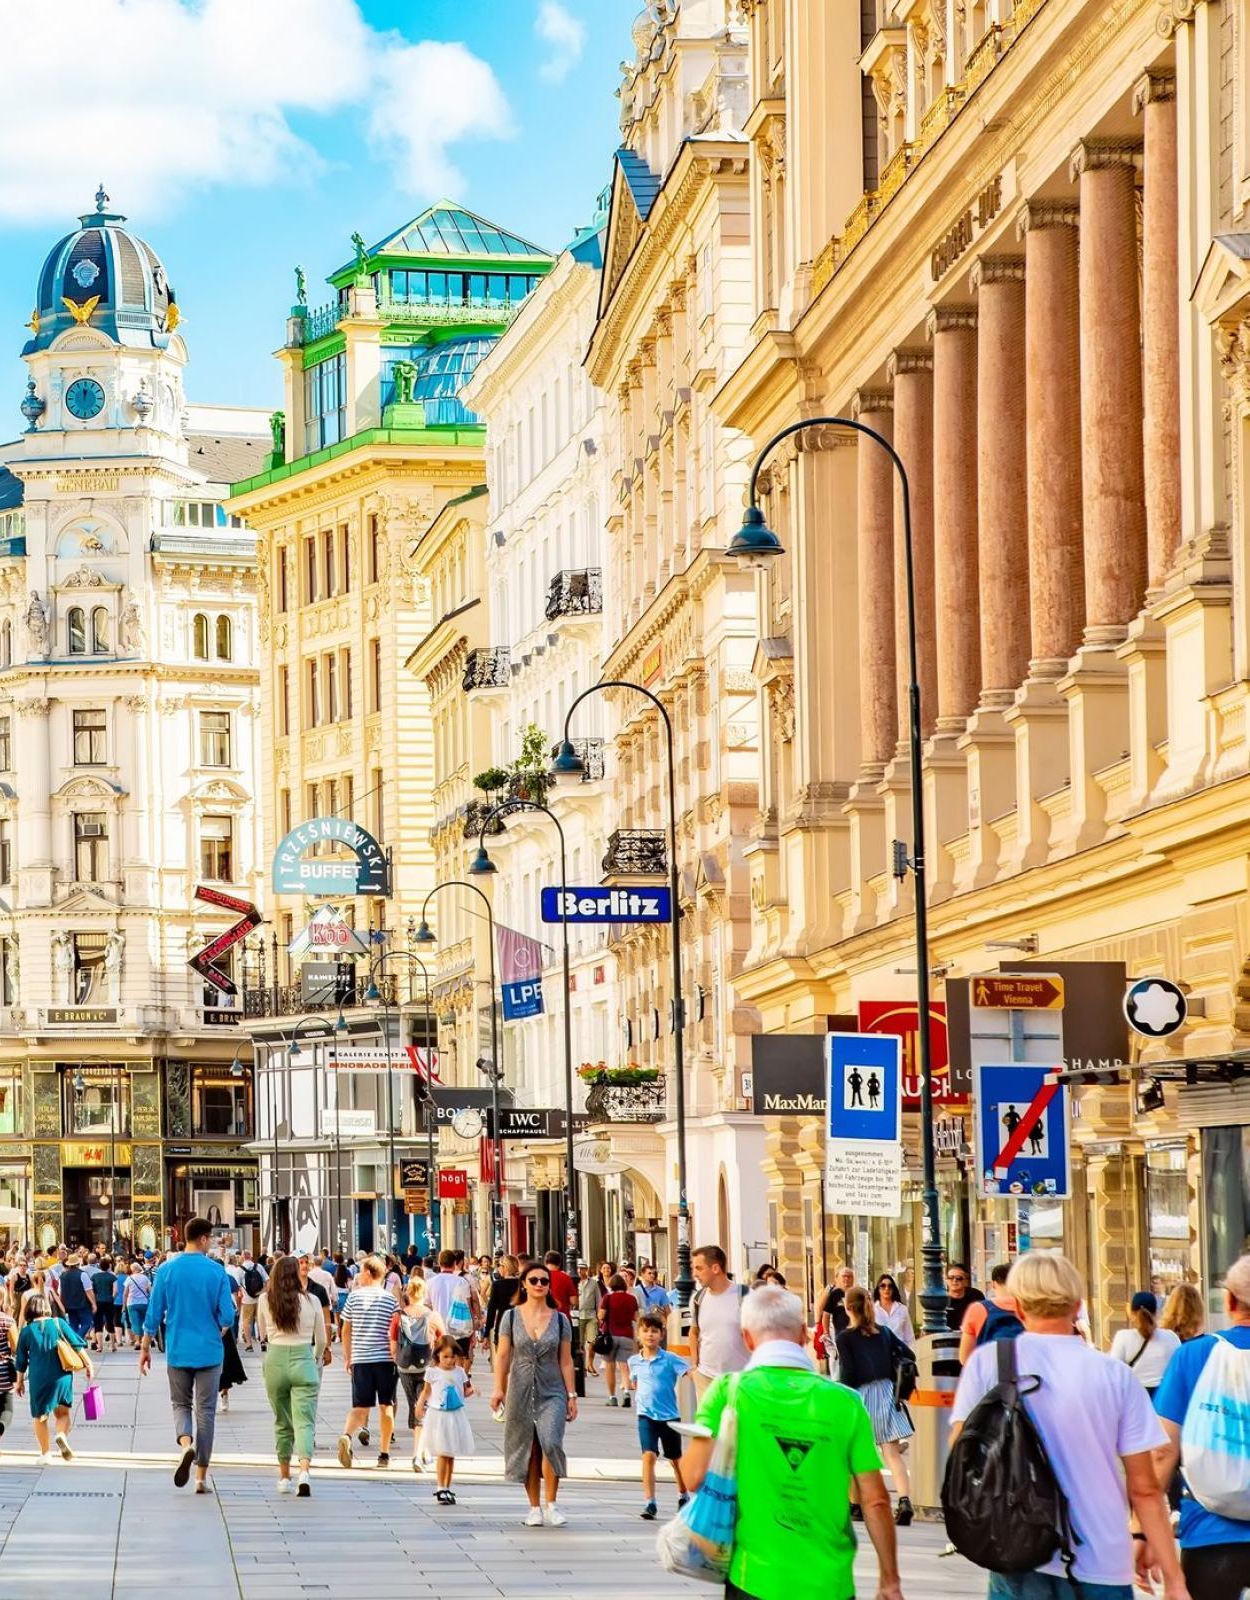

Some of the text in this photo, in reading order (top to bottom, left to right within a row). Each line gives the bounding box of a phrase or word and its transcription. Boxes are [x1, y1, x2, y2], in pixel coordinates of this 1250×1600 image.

[300, 864, 362, 878] BUFFET
[557, 890, 659, 915] Berlitz
[993, 982, 1043, 992] Time Travel
[1003, 995, 1033, 1004] Vienna
[509, 1113, 540, 1127] IWC
[441, 1174, 464, 1184] högl
